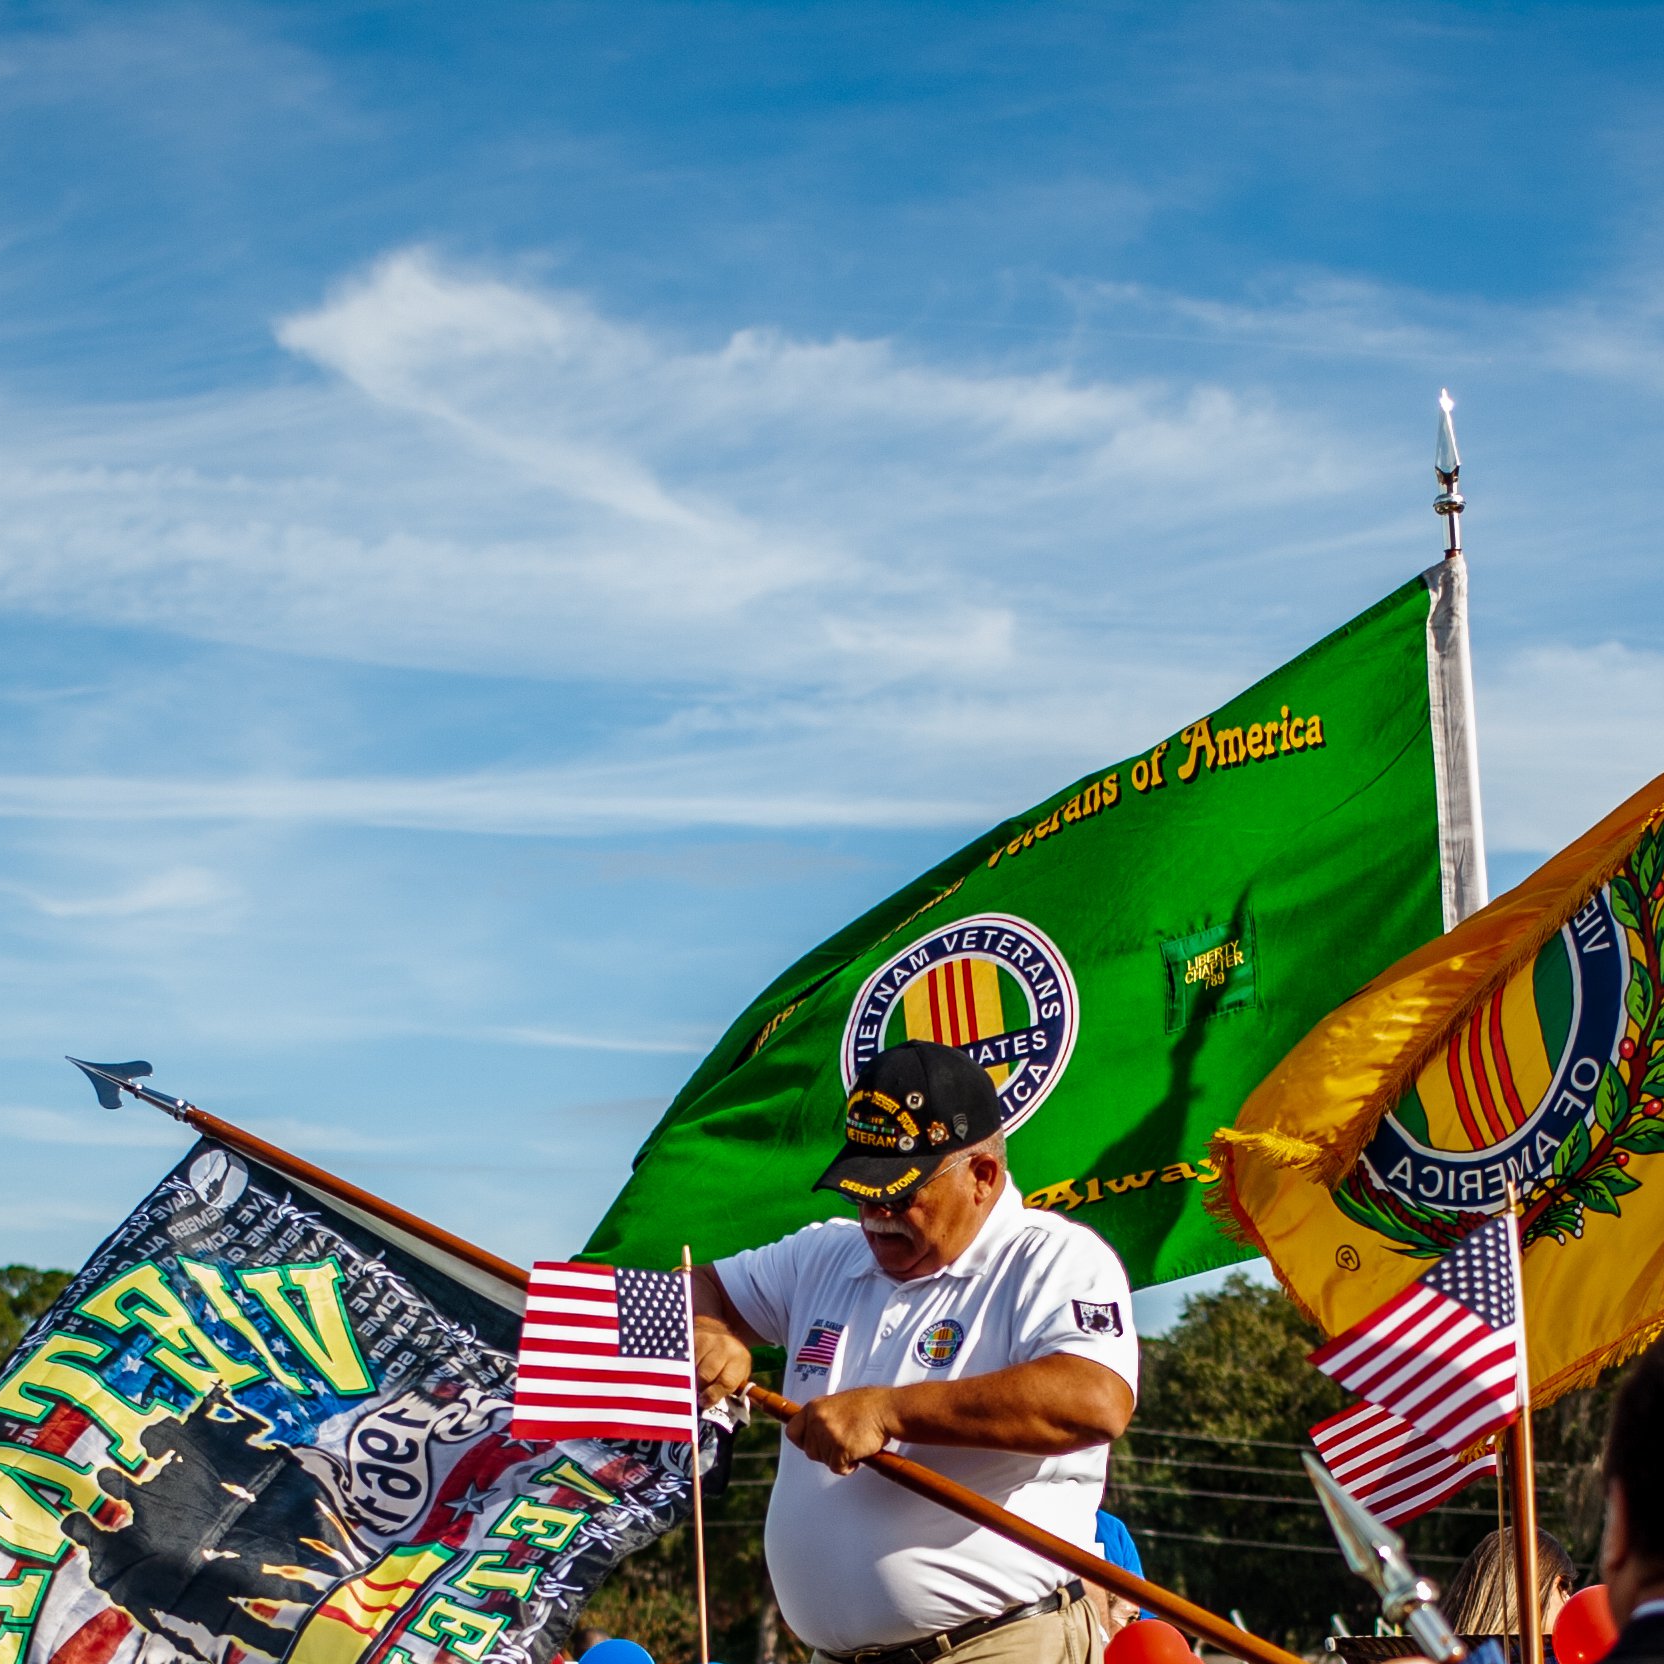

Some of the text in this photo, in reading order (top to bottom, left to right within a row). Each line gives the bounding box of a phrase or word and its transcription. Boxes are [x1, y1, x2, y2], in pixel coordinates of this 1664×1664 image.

[1131, 742, 1167, 793] of
[1178, 705, 1324, 782] America
[1185, 951, 1244, 985] CHAPTER
[1187, 940, 1239, 972] LIBERTY
[943, 929, 1061, 1019] VETERANS
[1204, 971, 1225, 991] 789
[840, 1167, 921, 1198] DESERT STORM
[1023, 1159, 1222, 1211] Alway
